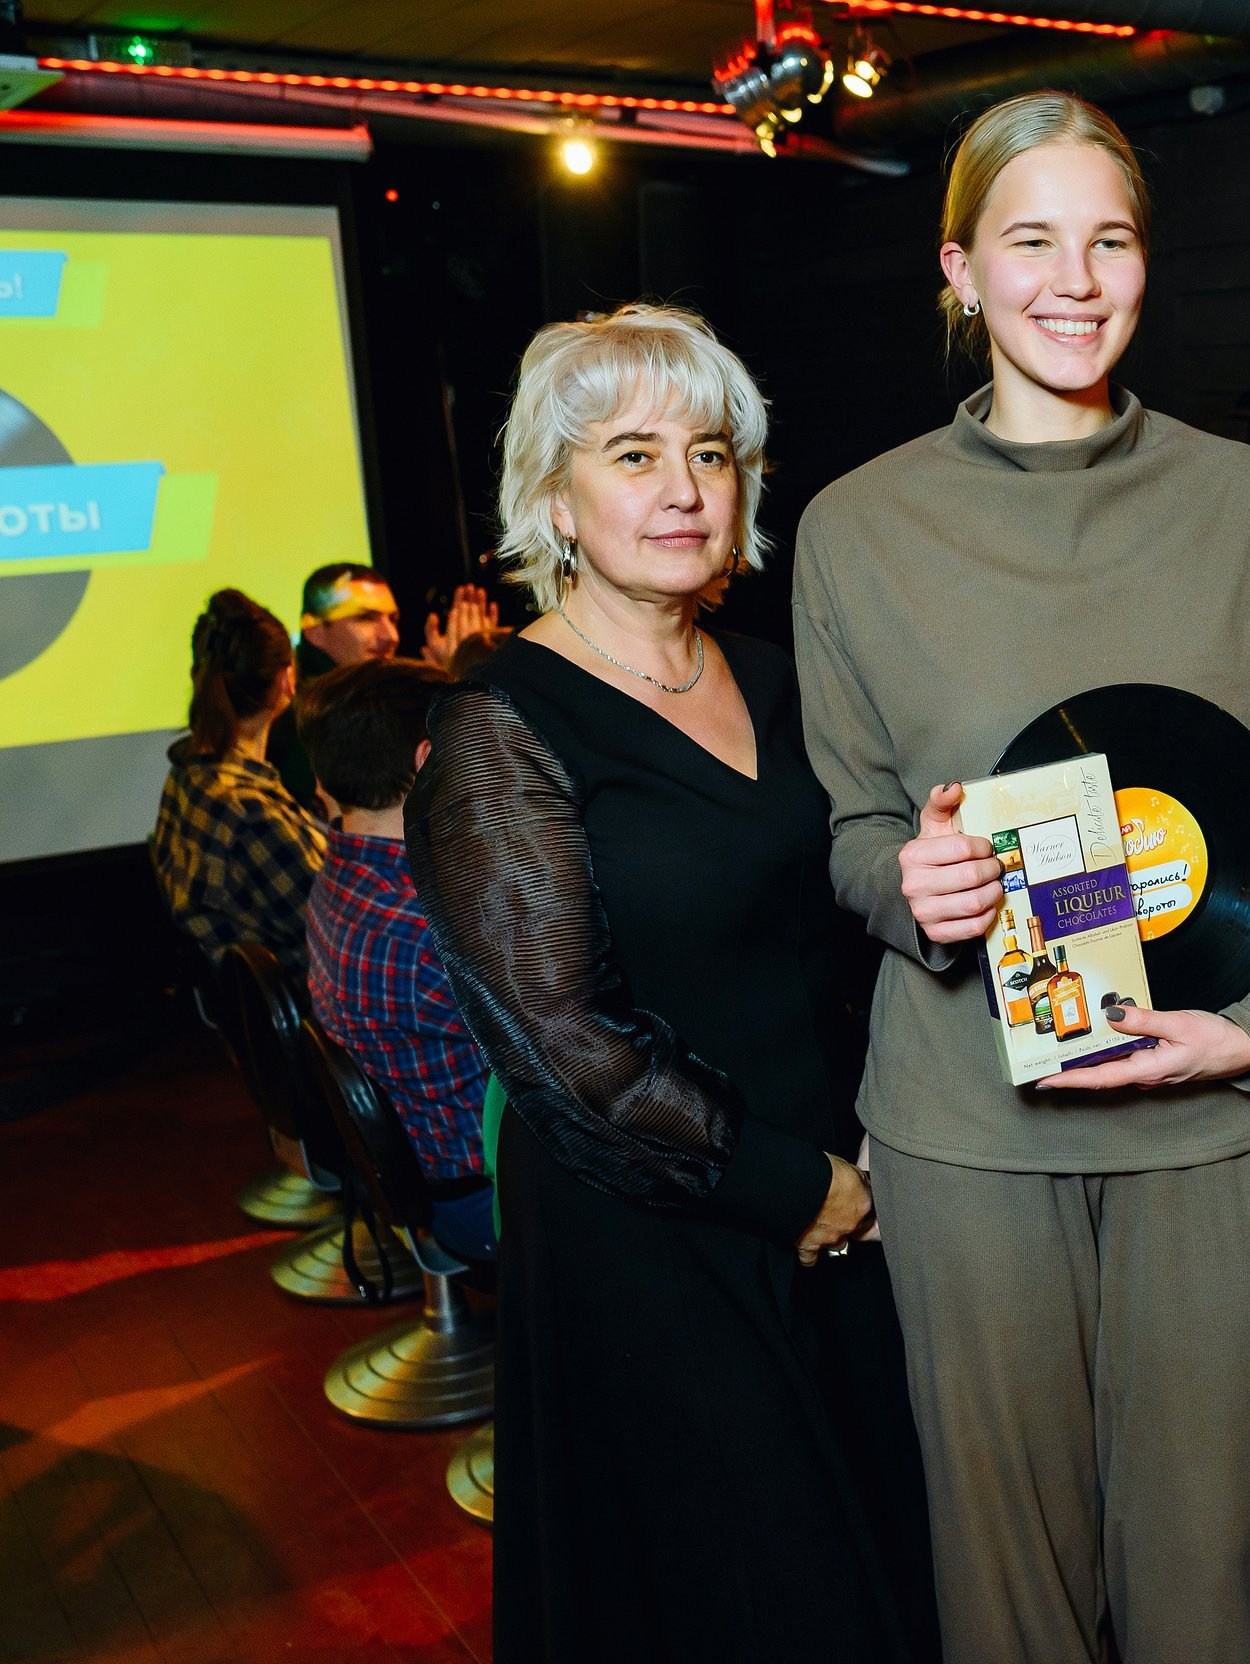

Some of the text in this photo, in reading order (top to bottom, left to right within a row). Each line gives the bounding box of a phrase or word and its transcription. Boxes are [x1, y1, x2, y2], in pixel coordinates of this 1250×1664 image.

[1080, 766, 1118, 866] Delicate taste
[1026, 841, 1065, 856] Warner
[1125, 818, 1167, 857] одию
[1040, 851, 1072, 865] Hudson
[1052, 879, 1098, 899] ASSORTED
[1129, 863, 1188, 896] арались!
[1055, 885, 1126, 917] LIQUEUR
[1134, 897, 1176, 922] вороты
[1057, 905, 1117, 929] CHOCOLATES
[1009, 977, 1028, 986] SCOTCH
